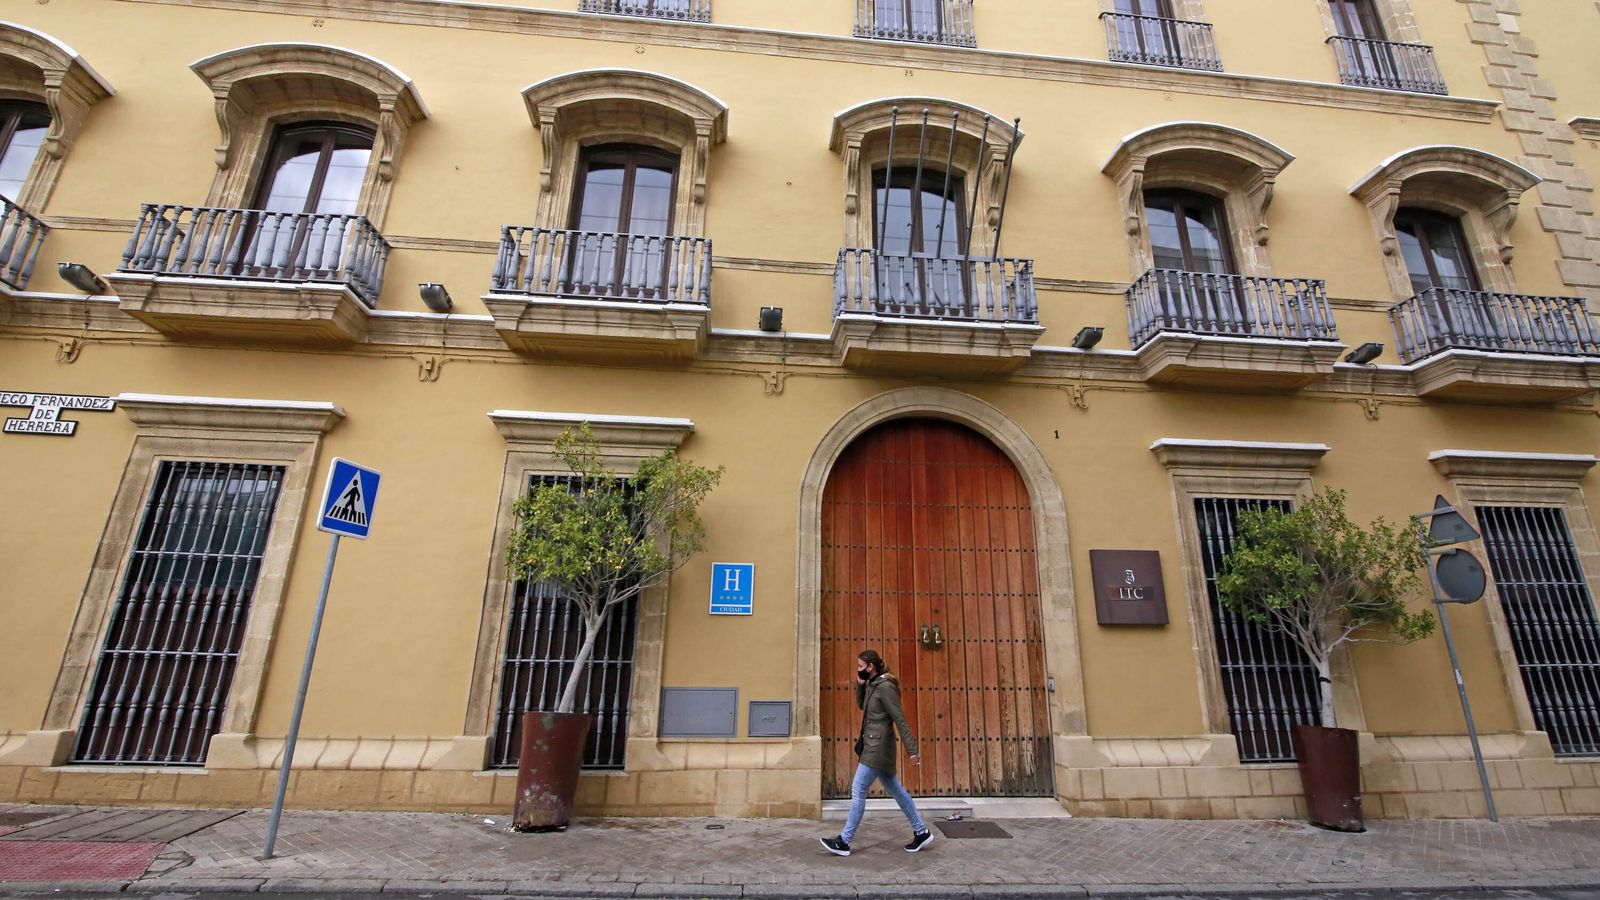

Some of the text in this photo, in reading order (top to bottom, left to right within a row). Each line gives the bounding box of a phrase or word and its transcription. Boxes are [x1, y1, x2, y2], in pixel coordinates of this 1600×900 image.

[0, 393, 110, 409] EGO FERNANDEZ
[34, 408, 54, 420] DE
[7, 420, 70, 433] HERRERA
[1054, 430, 1060, 439] 1
[723, 568, 742, 591] H
